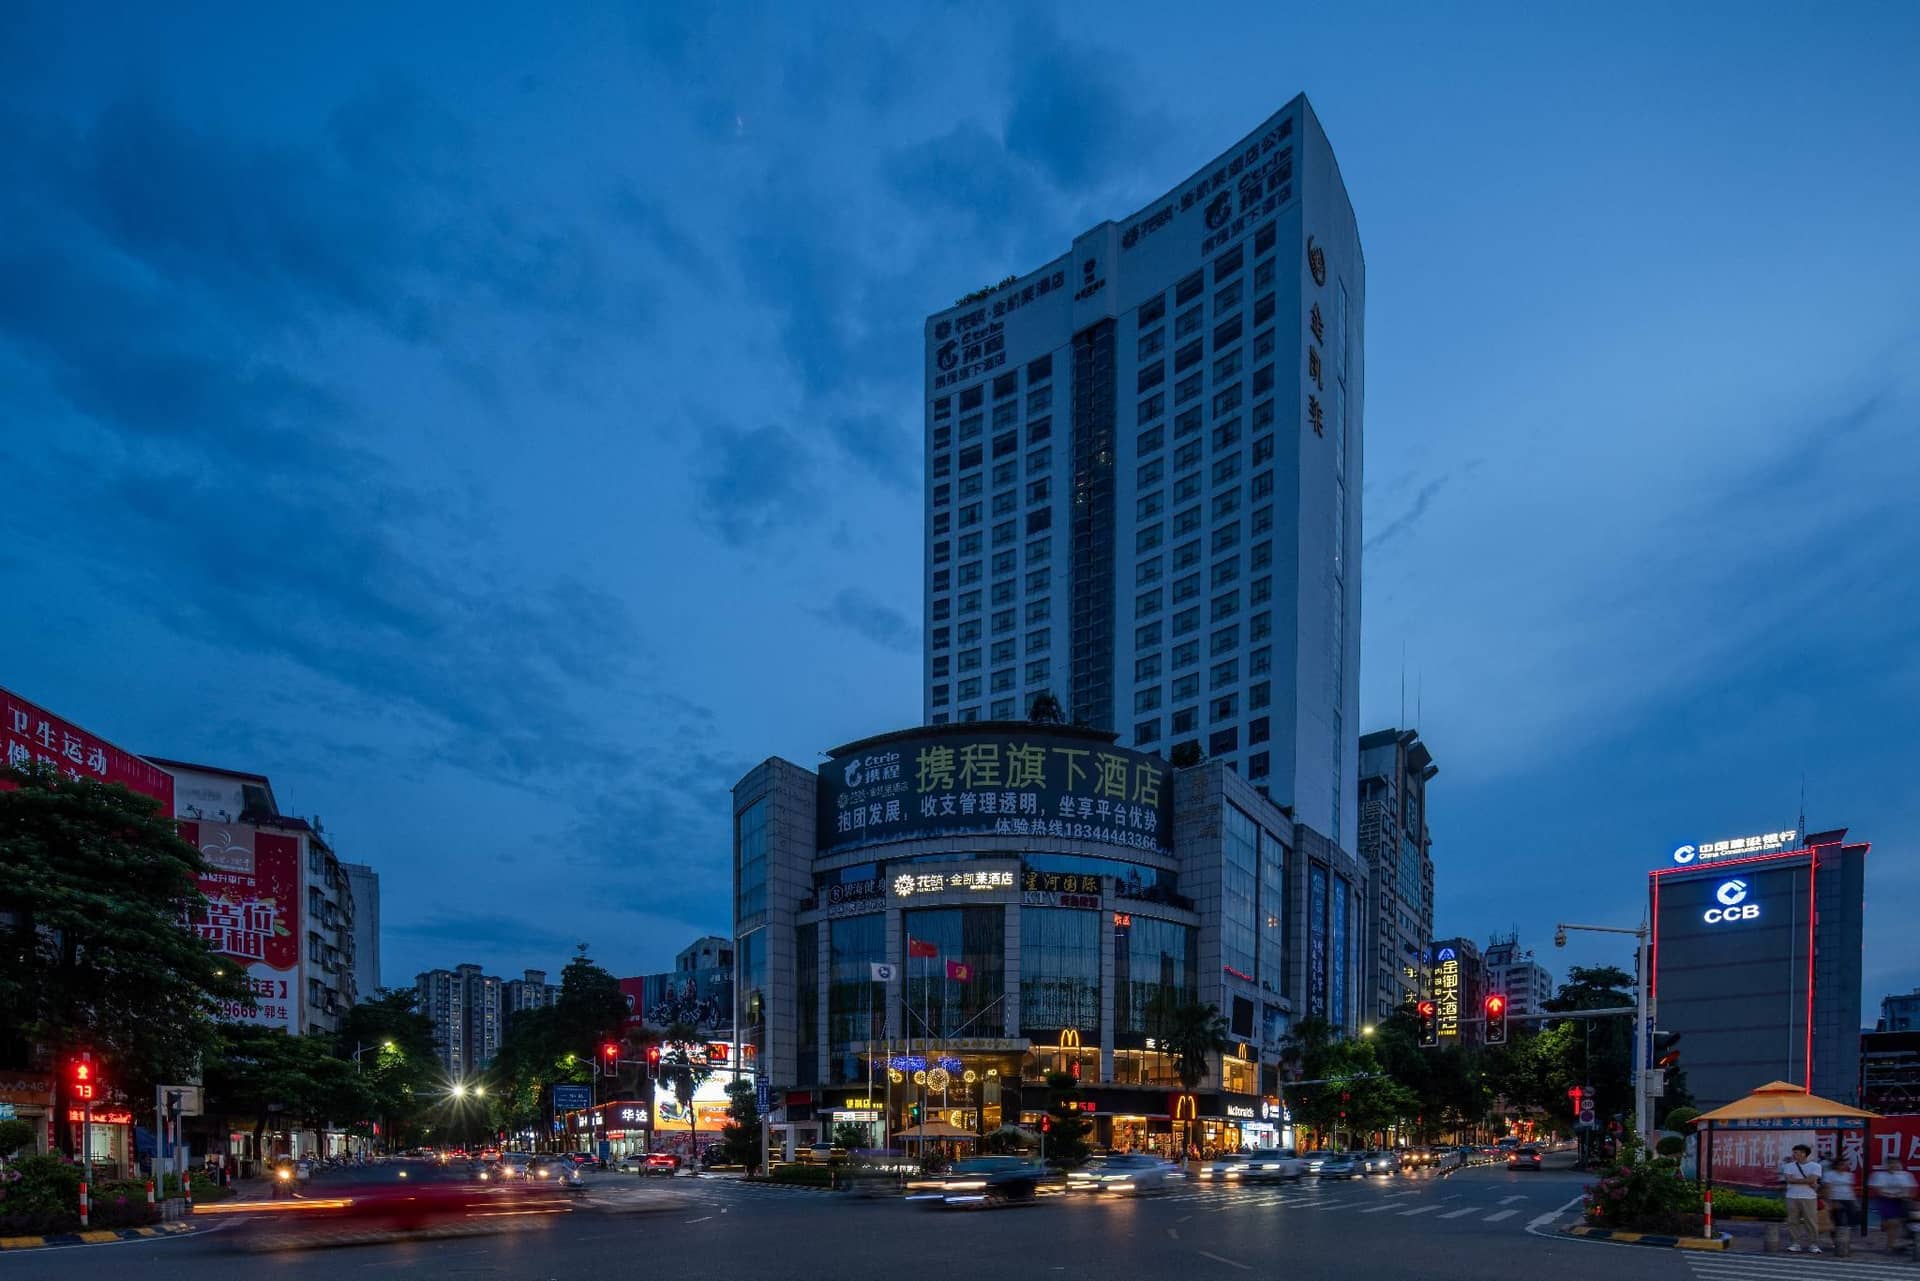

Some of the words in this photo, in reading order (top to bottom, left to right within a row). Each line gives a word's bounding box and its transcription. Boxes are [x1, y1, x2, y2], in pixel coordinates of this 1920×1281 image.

[7, 705, 108, 777] 卫生运动
[914, 741, 1164, 810] 携程旗下酒店
[1058, 794, 1159, 833] 坐享平台优势
[1024, 871, 1099, 894] 星河国际
[1023, 890, 1059, 906] KTV
[1703, 904, 1761, 924] CCB
[75, 1085, 92, 1098] 73
[621, 1109, 649, 1122] 华达
